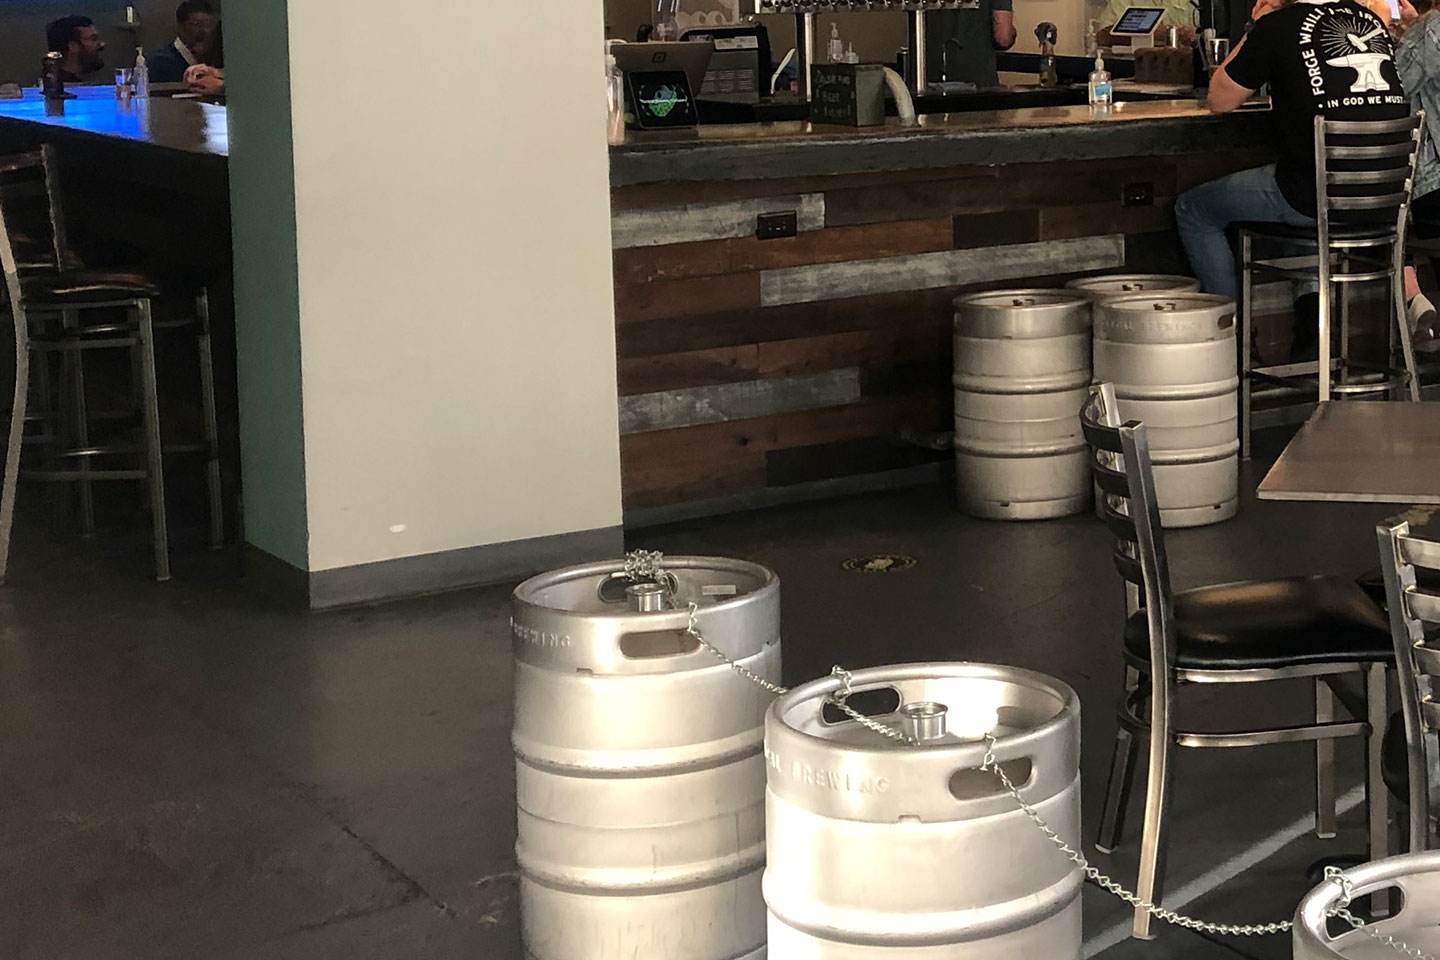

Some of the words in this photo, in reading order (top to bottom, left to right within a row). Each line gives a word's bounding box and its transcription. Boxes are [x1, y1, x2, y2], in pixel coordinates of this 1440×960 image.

[1301, 48, 1325, 96] FORGE
[1327, 99, 1339, 109] IN
[1343, 97, 1364, 106] GOD
[1367, 96, 1381, 104] WE
